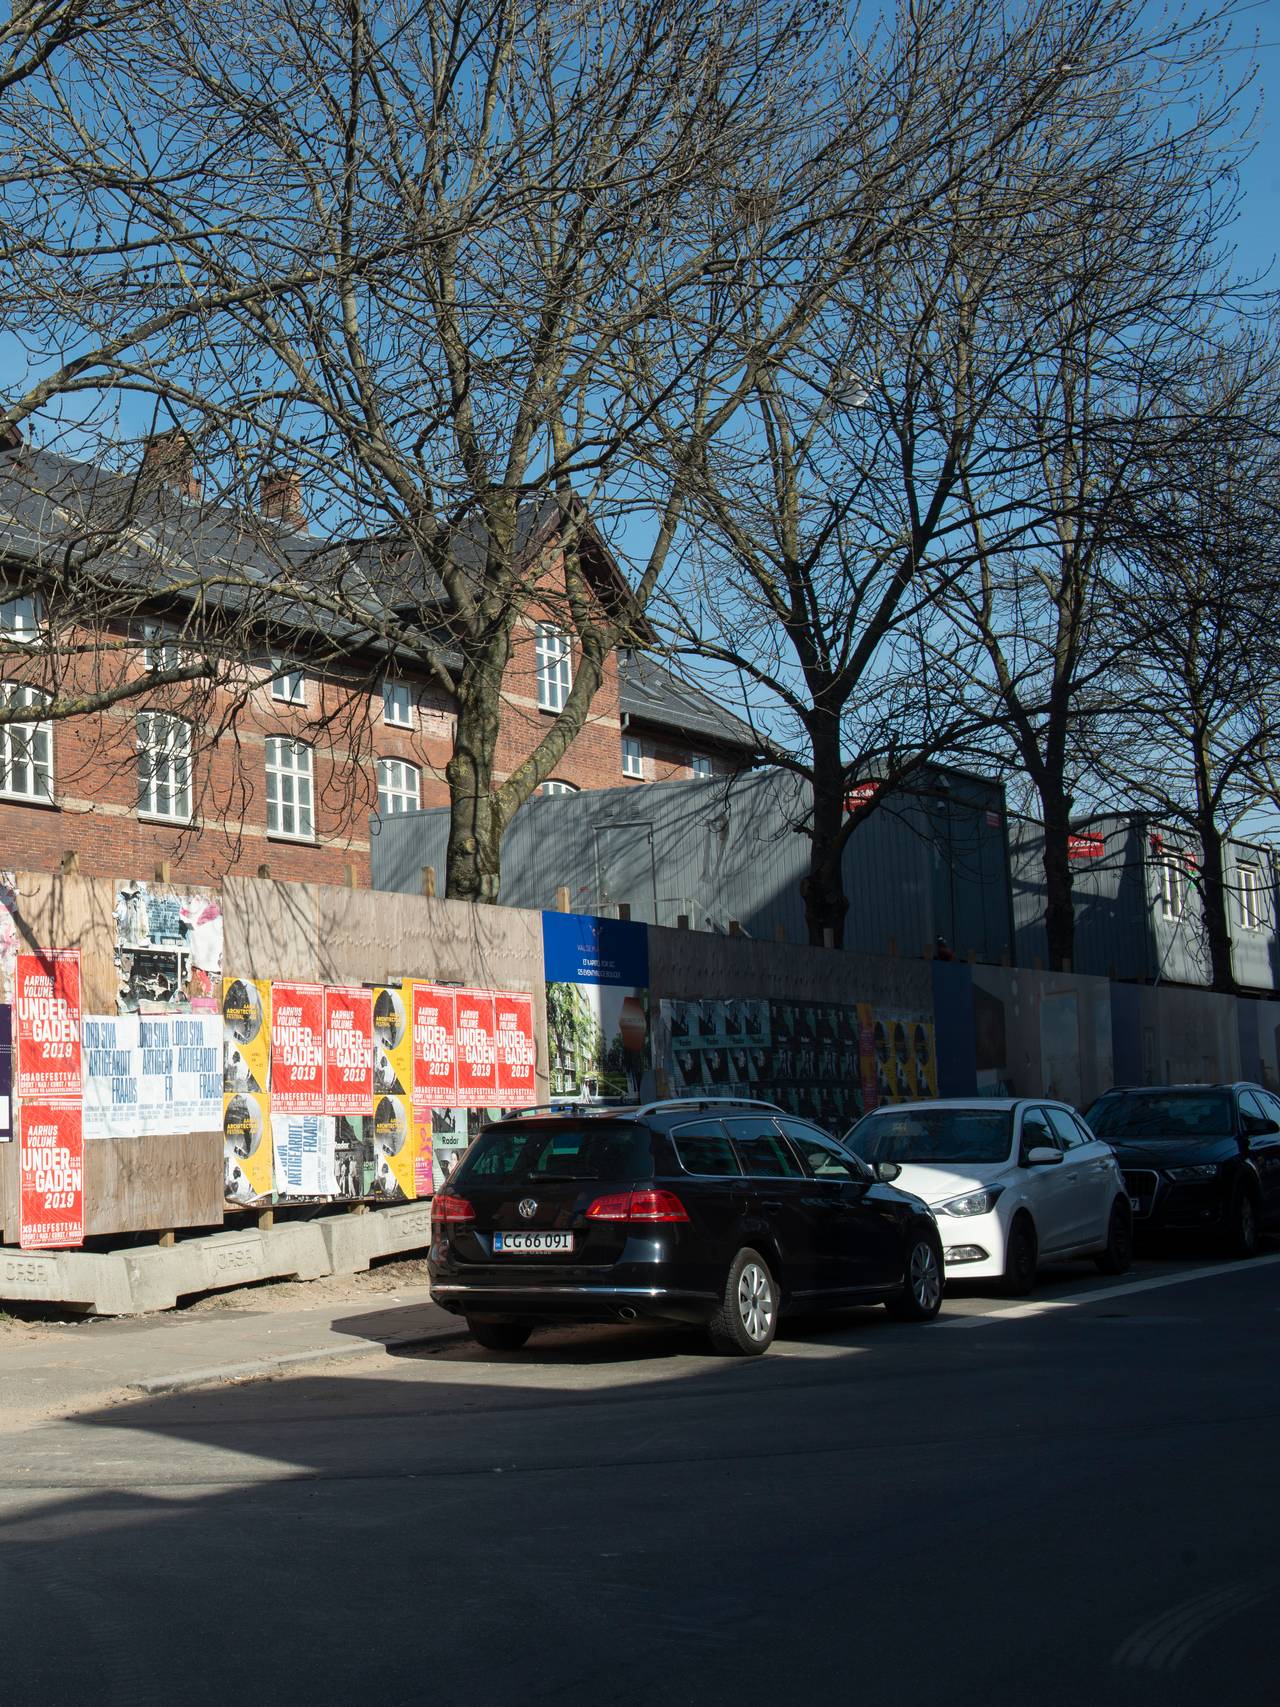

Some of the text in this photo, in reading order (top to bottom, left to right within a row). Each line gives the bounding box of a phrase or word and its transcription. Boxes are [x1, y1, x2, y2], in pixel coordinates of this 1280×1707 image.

[24, 976, 55, 986] AARHUS
[23, 986, 54, 997] VOLUME
[19, 997, 67, 1020] UNDER
[277, 1007, 302, 1016] AARHUS
[331, 1010, 354, 1019] AARHUS
[418, 1007, 438, 1016] AARHUS
[460, 1010, 479, 1019] AARHUS
[277, 1016, 301, 1026] VOLUME
[331, 1019, 353, 1029] VOLUME
[418, 1016, 438, 1026] VOLUME
[460, 1019, 478, 1028] VOLUME
[500, 1013, 518, 1022] AARHUS
[32, 1020, 79, 1042] GADEN
[499, 1021, 517, 1031] VOLUME
[101, 1023, 116, 1049] SIVA
[154, 1022, 169, 1048] SIVA
[172, 1021, 204, 1046] LORD SIVA
[273, 1026, 312, 1047] UNDER
[327, 1029, 363, 1048] UNDER
[414, 1025, 446, 1044] UNDER
[457, 1028, 486, 1046] UNDER
[496, 1030, 525, 1048] UNDER
[42, 1043, 73, 1058] 2019
[284, 1046, 322, 1066] GADEN
[423, 1043, 454, 1062] GADEN
[466, 1045, 495, 1064] GADEN
[505, 1046, 534, 1065] GADEN
[336, 1048, 371, 1068] GADEN
[290, 1067, 316, 1080] 2019
[343, 1068, 366, 1082] 2019
[429, 1062, 450, 1075] 2019
[471, 1064, 491, 1077] 2019
[511, 1065, 529, 1078] 2019
[28, 1125, 58, 1136] AARHUS
[27, 1136, 56, 1147] VOLUME
[442, 1136, 459, 1145] Radar
[22, 1148, 70, 1171] UNDER
[36, 1170, 80, 1192] GADEN
[44, 1192, 74, 1209] 2019
[504, 1234, 569, 1248] CG 66 091
